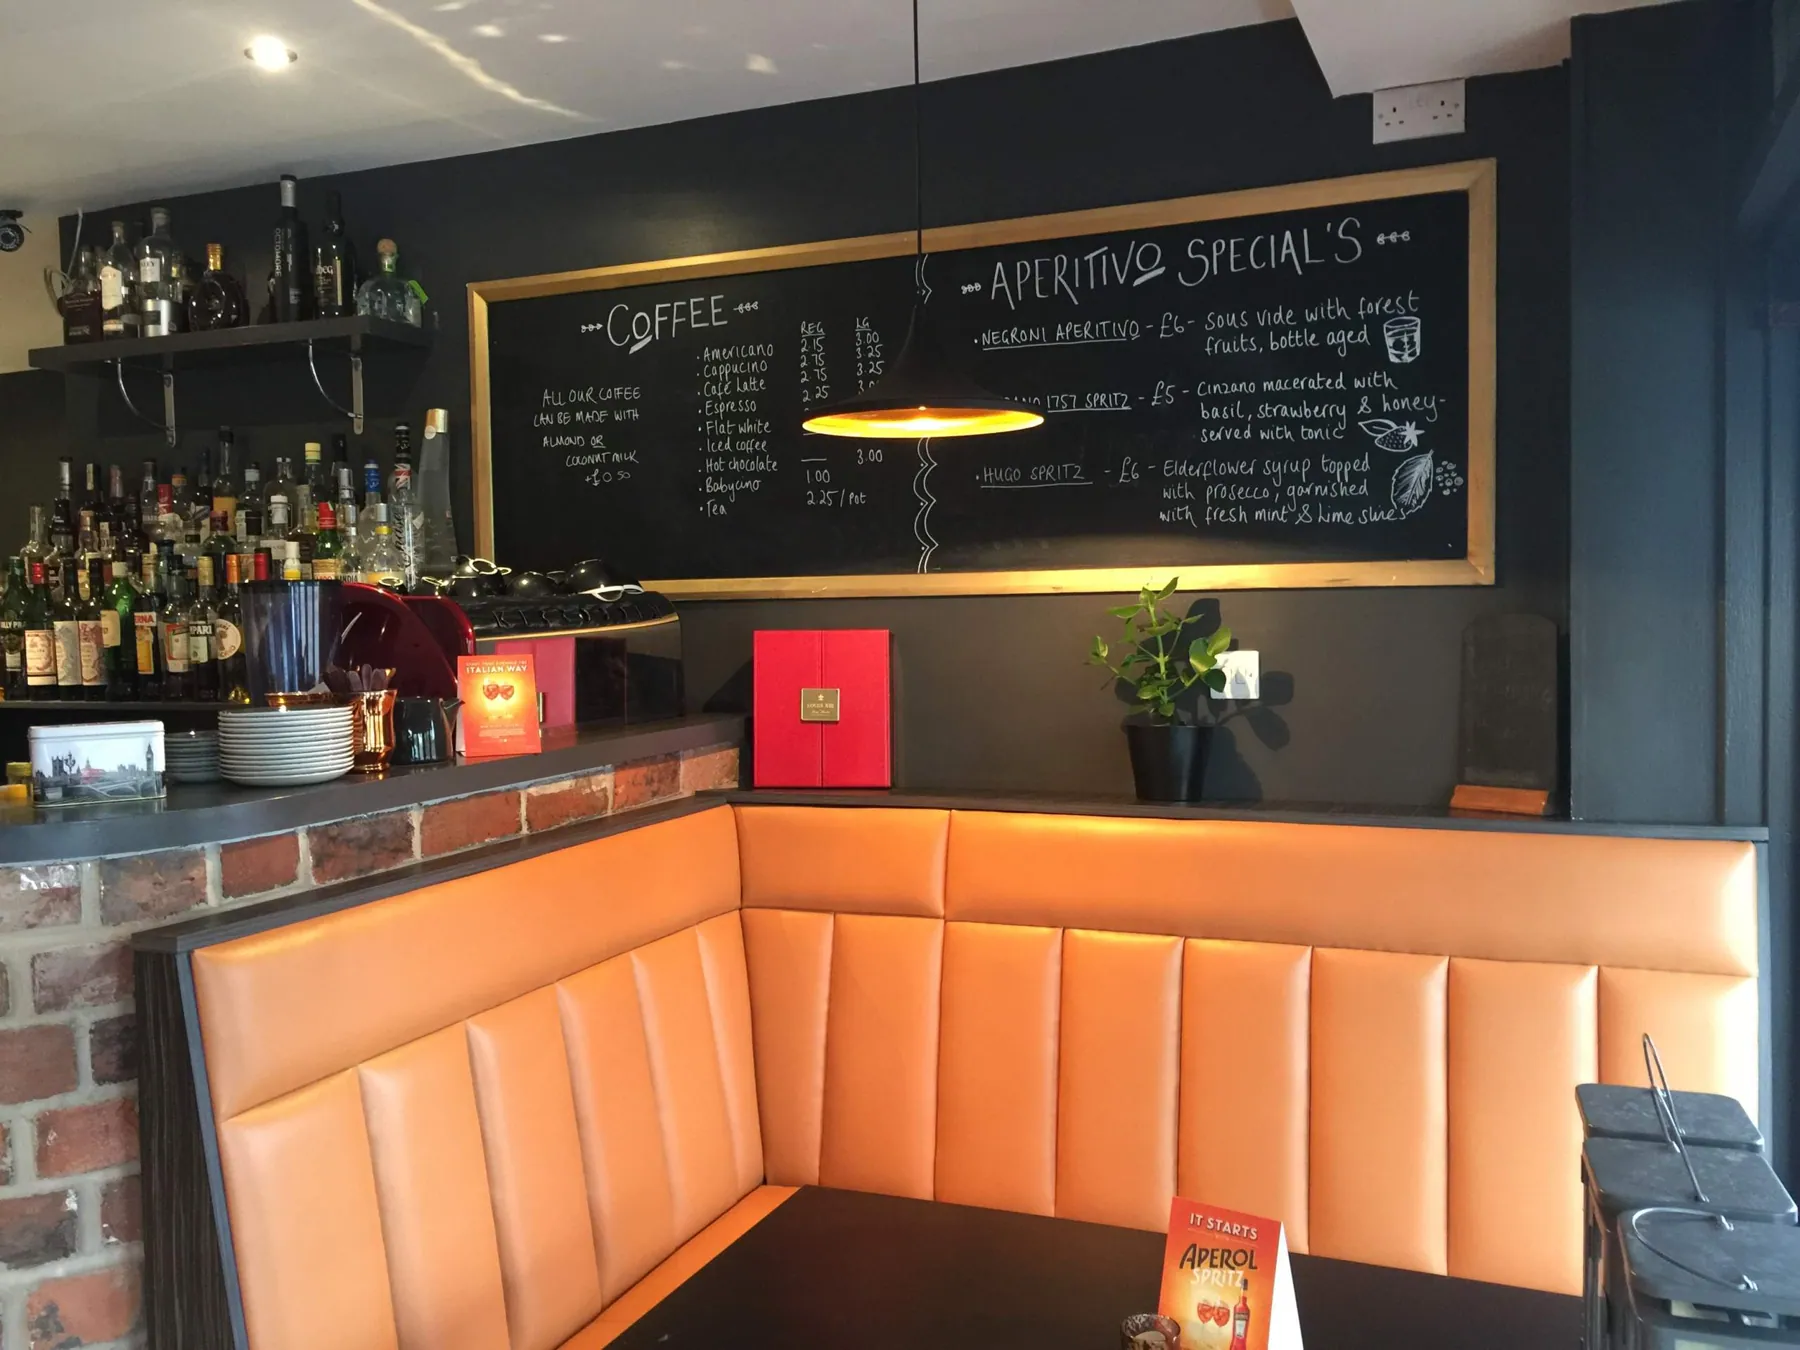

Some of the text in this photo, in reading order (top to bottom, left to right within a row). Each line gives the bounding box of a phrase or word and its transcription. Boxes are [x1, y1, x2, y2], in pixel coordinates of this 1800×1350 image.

[991, 217, 1363, 310] APERITIVO SPECIAL'S
[1205, 290, 1420, 331] sous vide with forest
[606, 295, 728, 348] COFFEE
[800, 316, 871, 336] REG LG
[855, 331, 880, 347] 3.00
[981, 326, 1047, 346] NEGRONI
[1056, 319, 1141, 342] APERITIVO
[1205, 324, 1371, 358] fruits, bottle aged
[703, 343, 774, 362] Americano
[855, 344, 884, 359] 3.25
[703, 360, 768, 382] Cappucino
[856, 360, 885, 376] 3.25
[1262, 371, 1347, 393] macerated
[1353, 370, 1399, 390] with
[542, 386, 642, 408] ALL OUR COFFEE
[1046, 394, 1077, 409] 1757
[1085, 392, 1132, 409] SPRITZ
[533, 408, 640, 427] CAN BE MADE WITH
[705, 399, 757, 420] Espresso
[1257, 400, 1347, 430] strawberry
[1357, 395, 1373, 415] &
[706, 417, 772, 436] Flat white
[1200, 423, 1346, 443] served with tonic
[543, 434, 605, 448] ALMOND OR
[706, 436, 768, 454] Iced coffee
[565, 449, 640, 468] COCONUT MILK
[705, 454, 779, 473] Hot chocolate
[856, 448, 883, 465] 3.00
[983, 466, 1022, 484] HUGO
[1029, 463, 1085, 482] SPRITZ
[1163, 452, 1371, 487] Elderflower syrup topped
[705, 476, 762, 503] Babycino
[1163, 483, 1195, 500] with
[1287, 478, 1369, 512] garnished
[706, 498, 727, 518] Tea
[1159, 507, 1198, 528] with
[1205, 504, 1248, 525] fresh
[1254, 506, 1290, 523] mint
[1294, 503, 1312, 525] &
[465, 664, 528, 674] ITALIAN WAY
[1189, 1212, 1259, 1241] IT STARTS
[1178, 1243, 1259, 1271] APEROL
